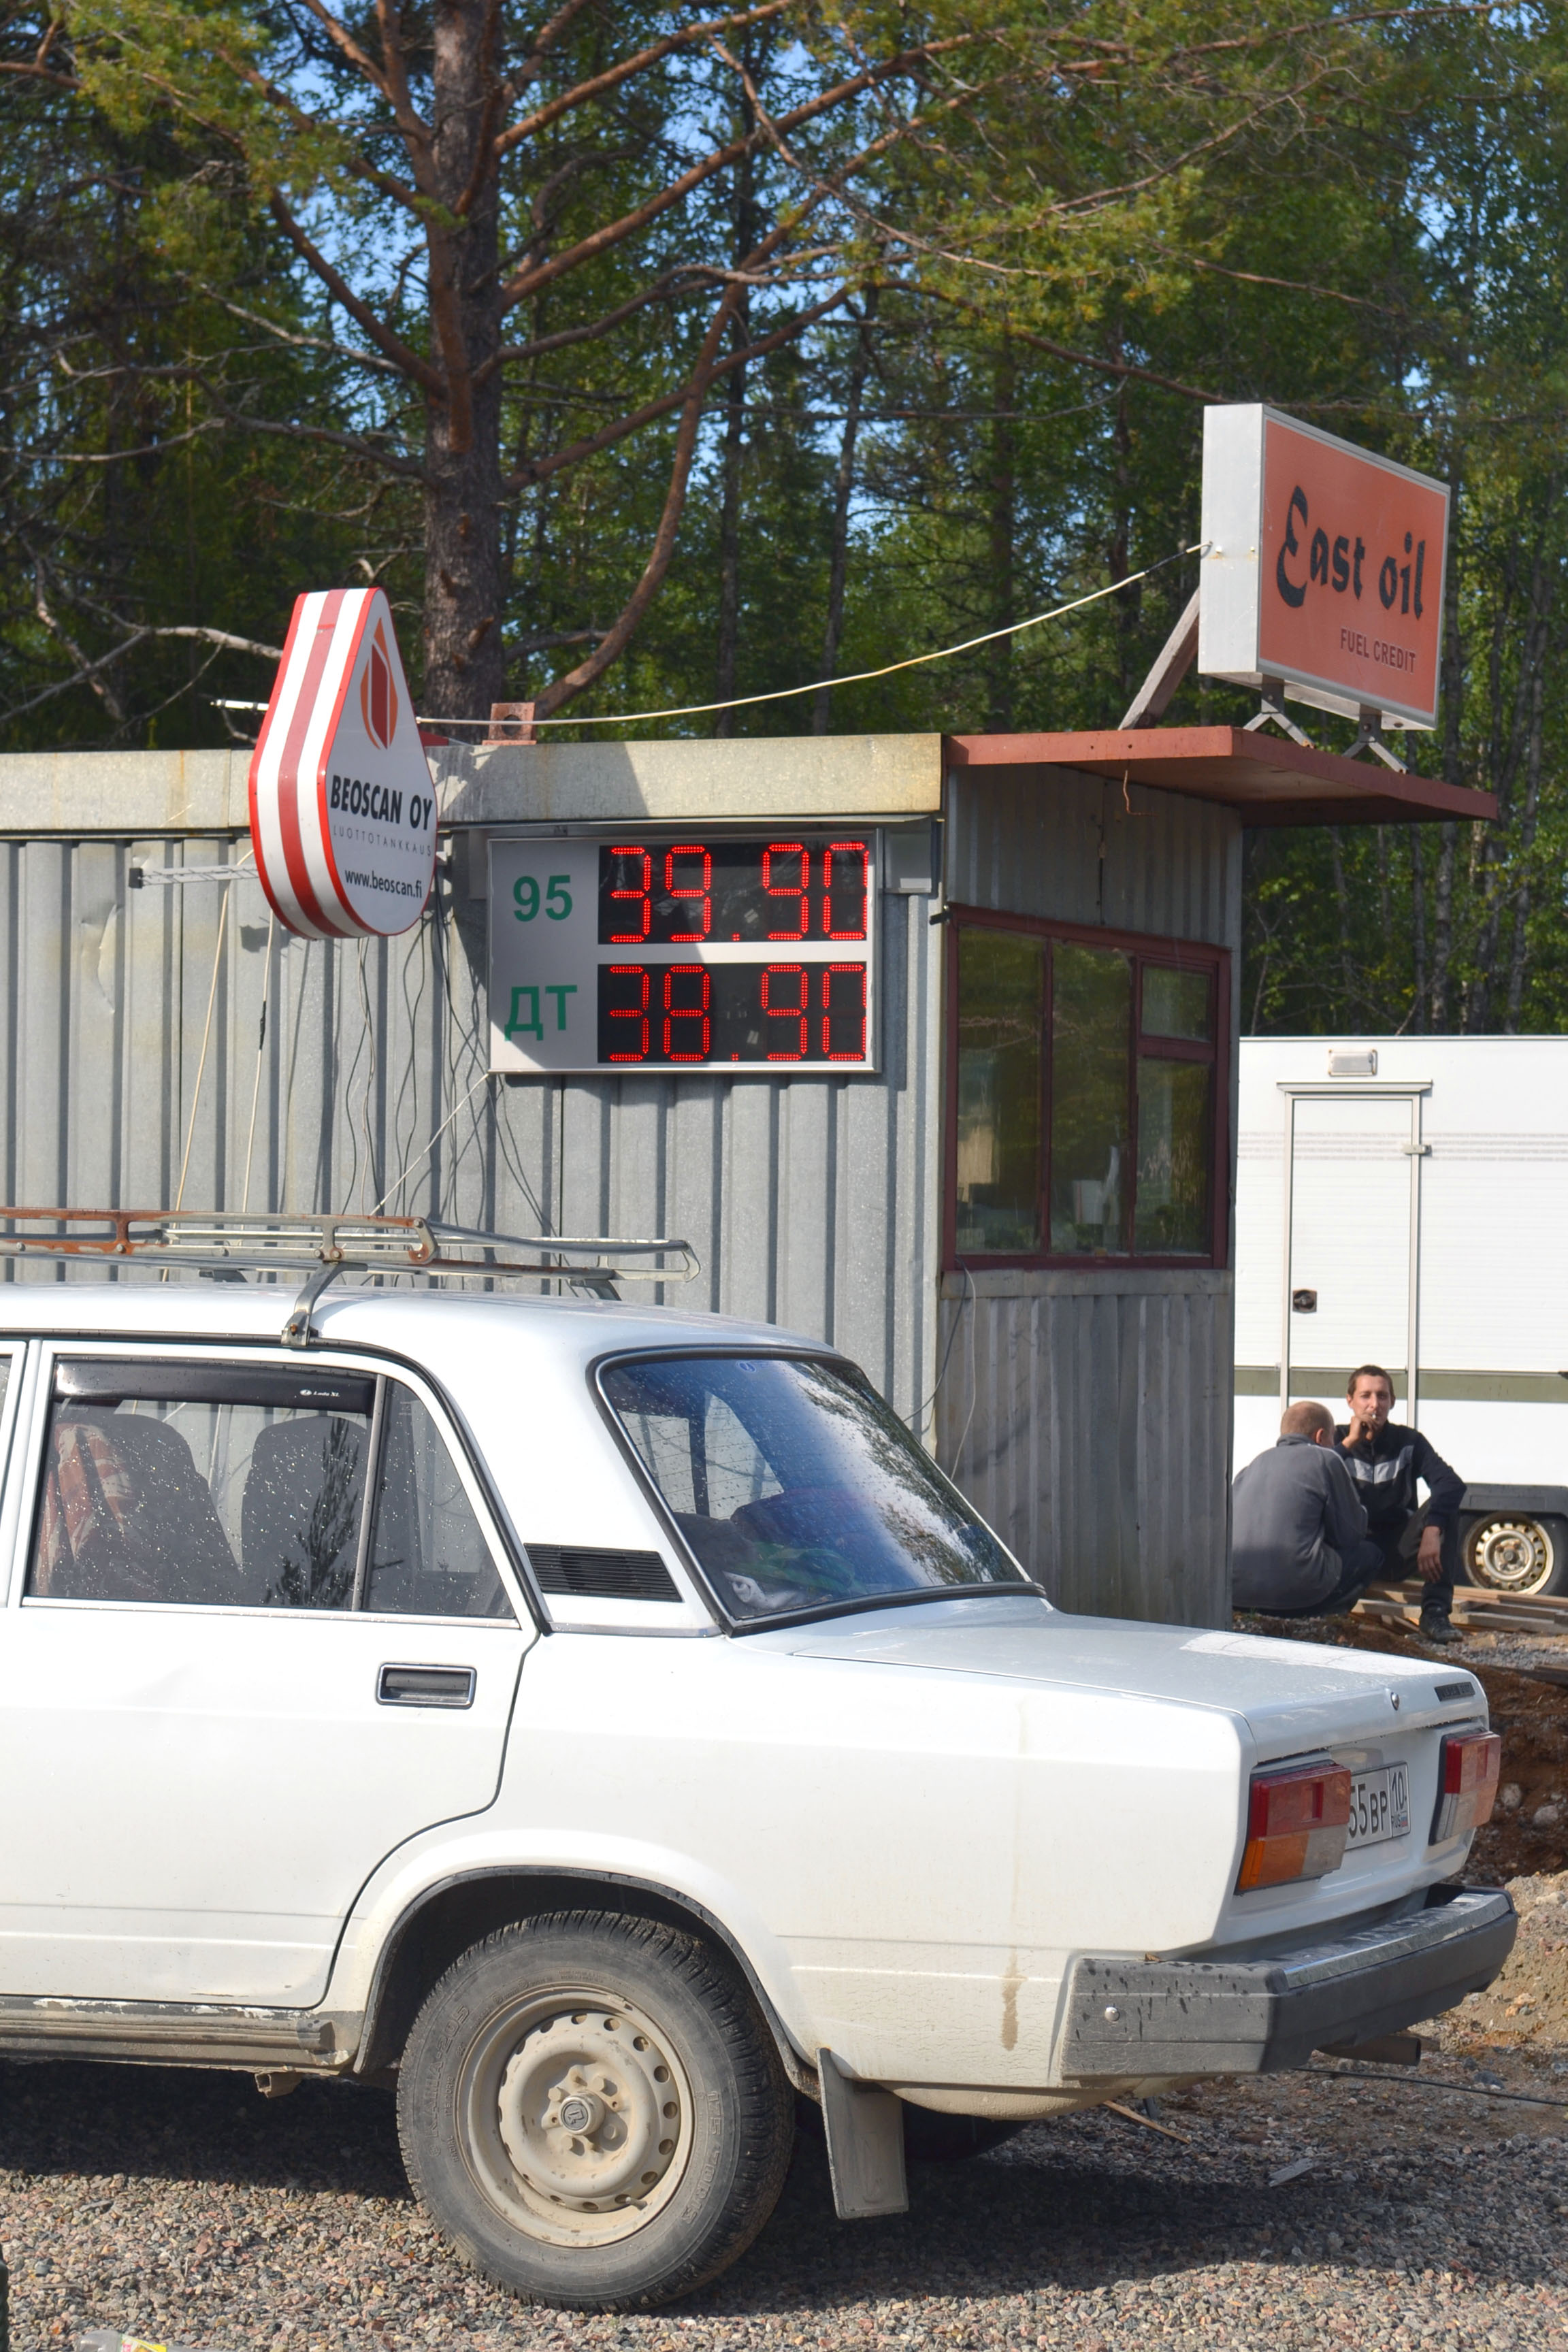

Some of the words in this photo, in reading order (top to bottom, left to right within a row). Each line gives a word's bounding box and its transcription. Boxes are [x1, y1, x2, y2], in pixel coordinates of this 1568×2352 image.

[1276, 485, 1365, 608] East
[1379, 532, 1426, 620] oil
[1341, 627, 1369, 658] FUEL
[1373, 640, 1416, 674] CREDIT
[330, 774, 403, 825] BEOSCAN
[409, 794, 433, 831] OY
[333, 824, 431, 857] LUOTTOTANKKAUS
[344, 869, 423, 899] www.beoscan.fi
[512, 874, 573, 922] 95
[504, 984, 578, 1041] ДТ
[1392, 1771, 1405, 1812] 10
